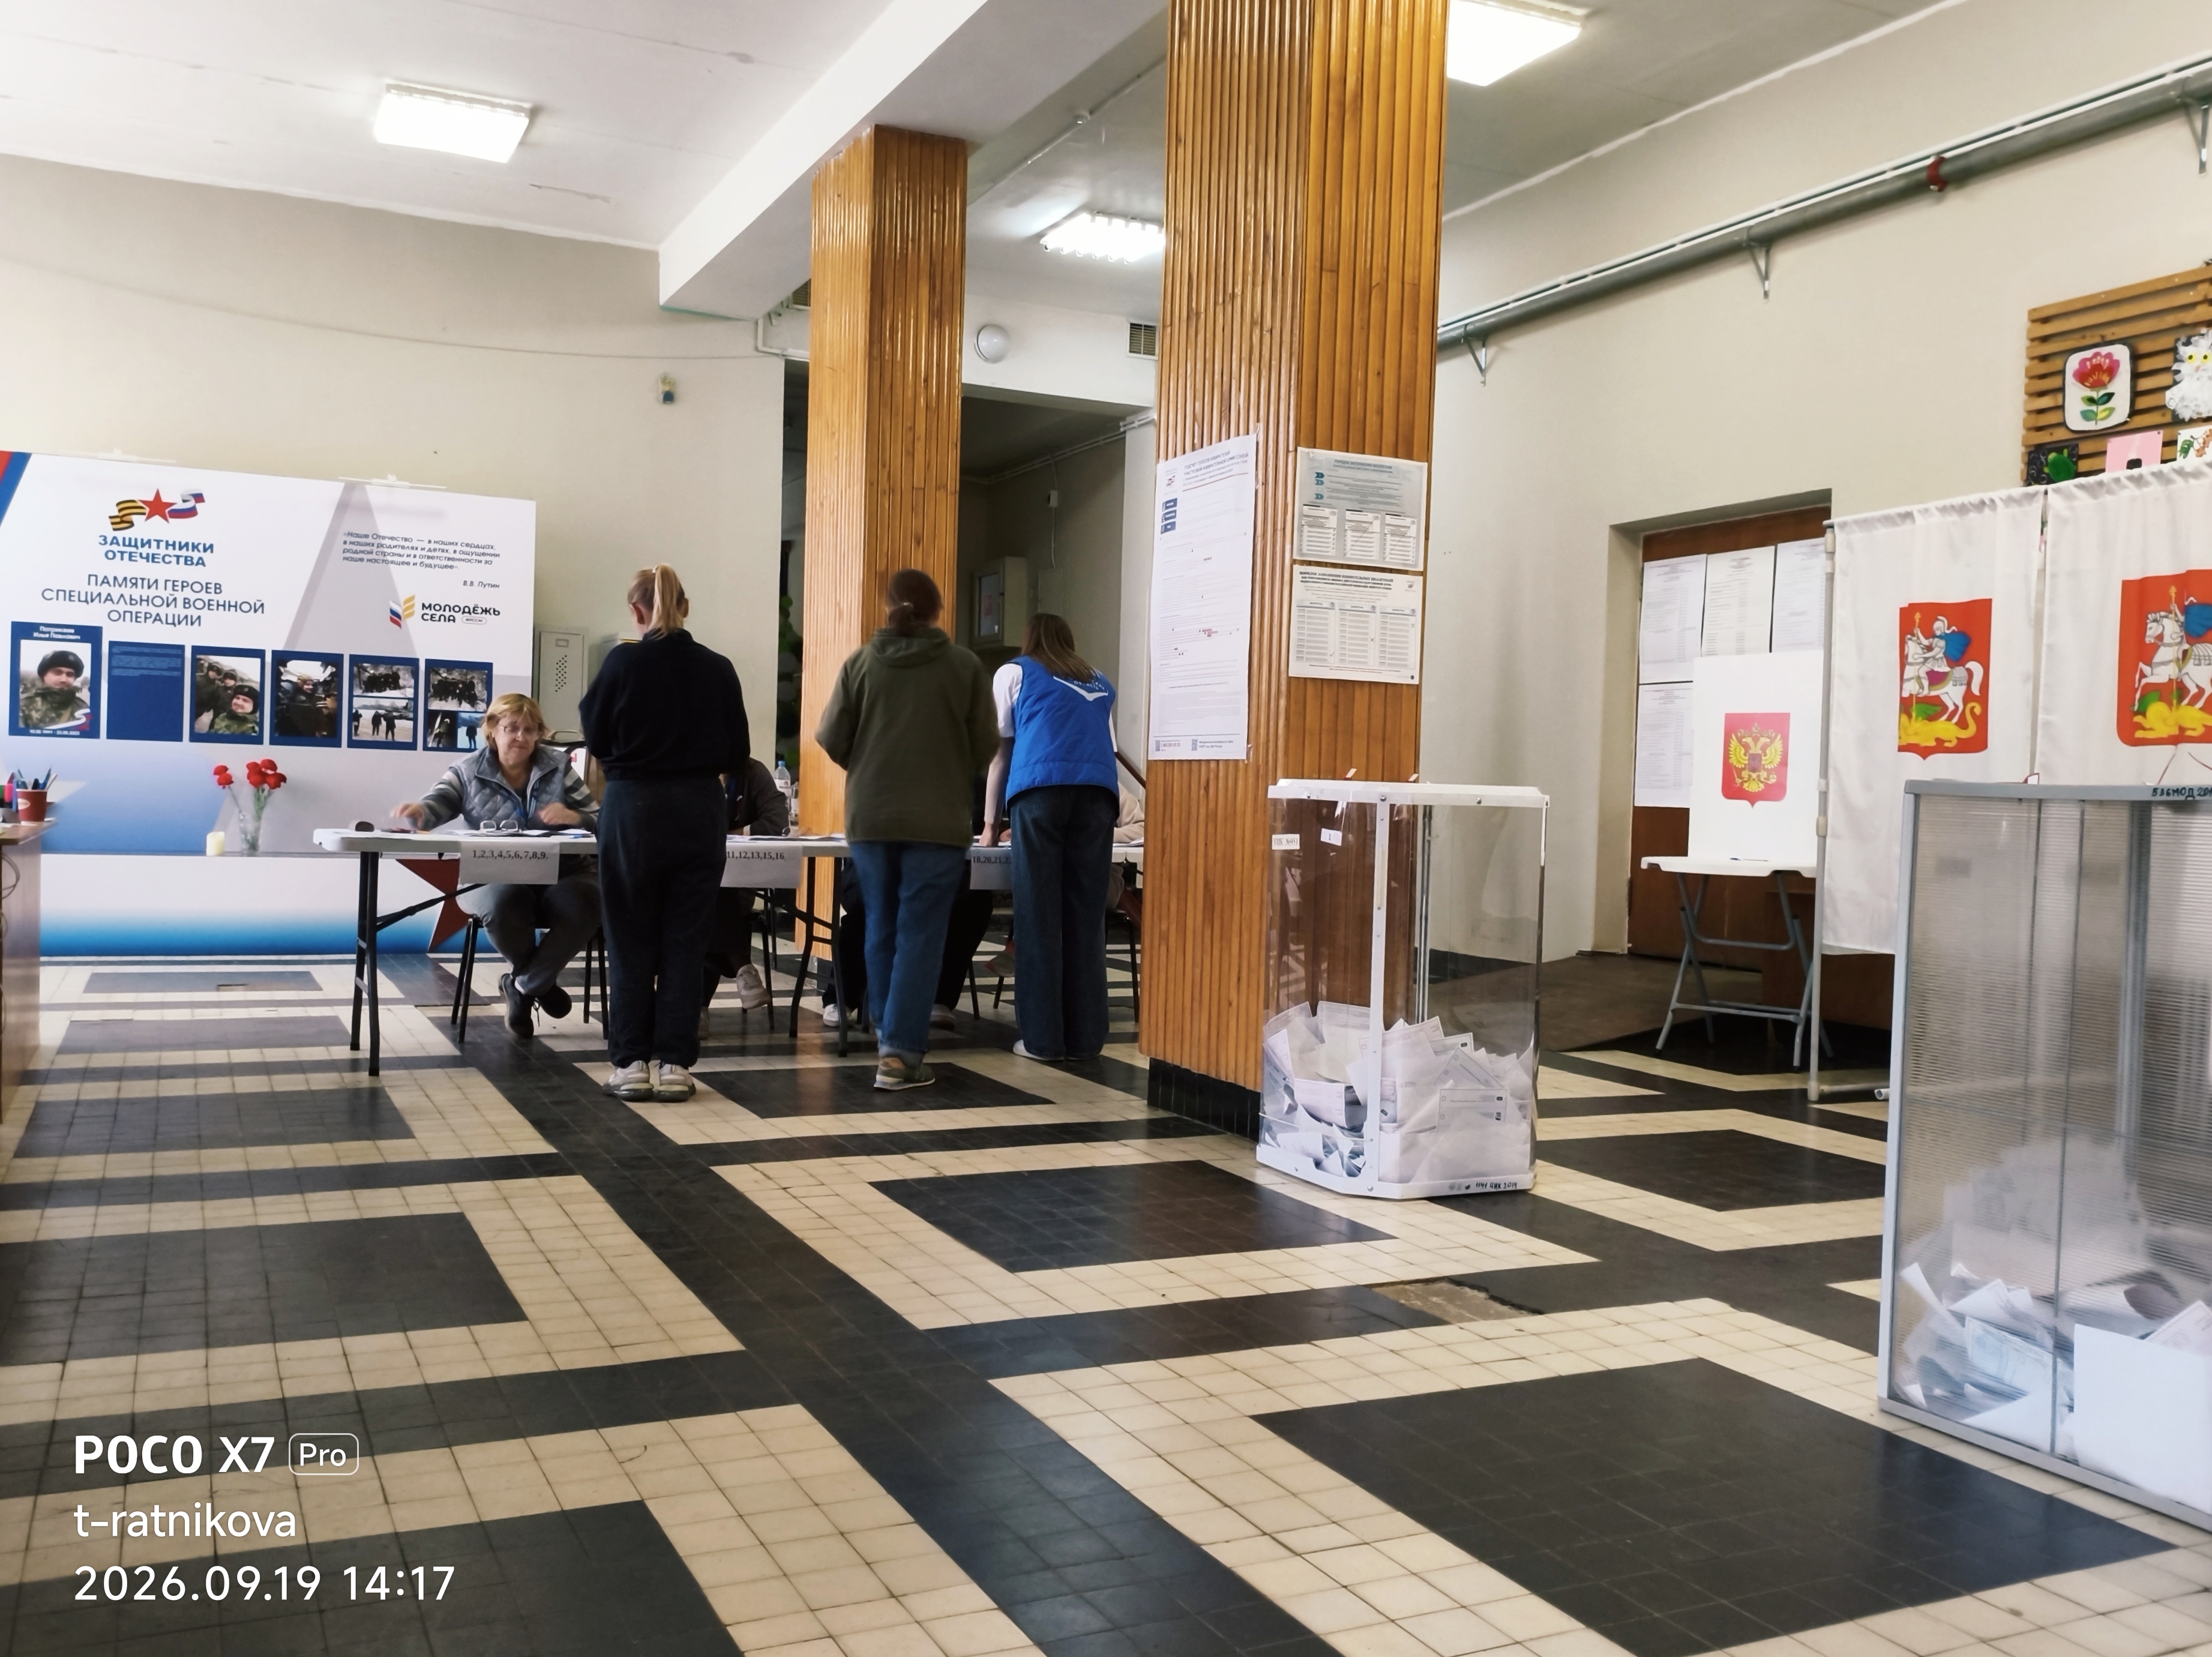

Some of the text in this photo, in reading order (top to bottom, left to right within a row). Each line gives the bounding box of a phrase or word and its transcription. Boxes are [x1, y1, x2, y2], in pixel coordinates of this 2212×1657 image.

[98, 535, 214, 553] ЗАЩИТНИКИ
[371, 533, 413, 543] Отечество
[460, 542, 496, 550] сердцах,
[104, 550, 206, 567] ОТЕЧЕСТВА
[376, 543, 418, 551] родителях
[458, 550, 500, 558] ощущении
[366, 558, 411, 566] настоящее
[418, 555, 482, 564] ответственности
[88, 574, 223, 595] ПАМЯТИ ГЕРОЕВ
[41, 588, 265, 614] СПЕЦИАЛЬНОЙ ВОЕННОЙ
[422, 602, 501, 616] МОЛОДЁЖЬ
[107, 609, 202, 627] ОПЕРАЦИИ
[421, 613, 456, 624] СЕЛА
